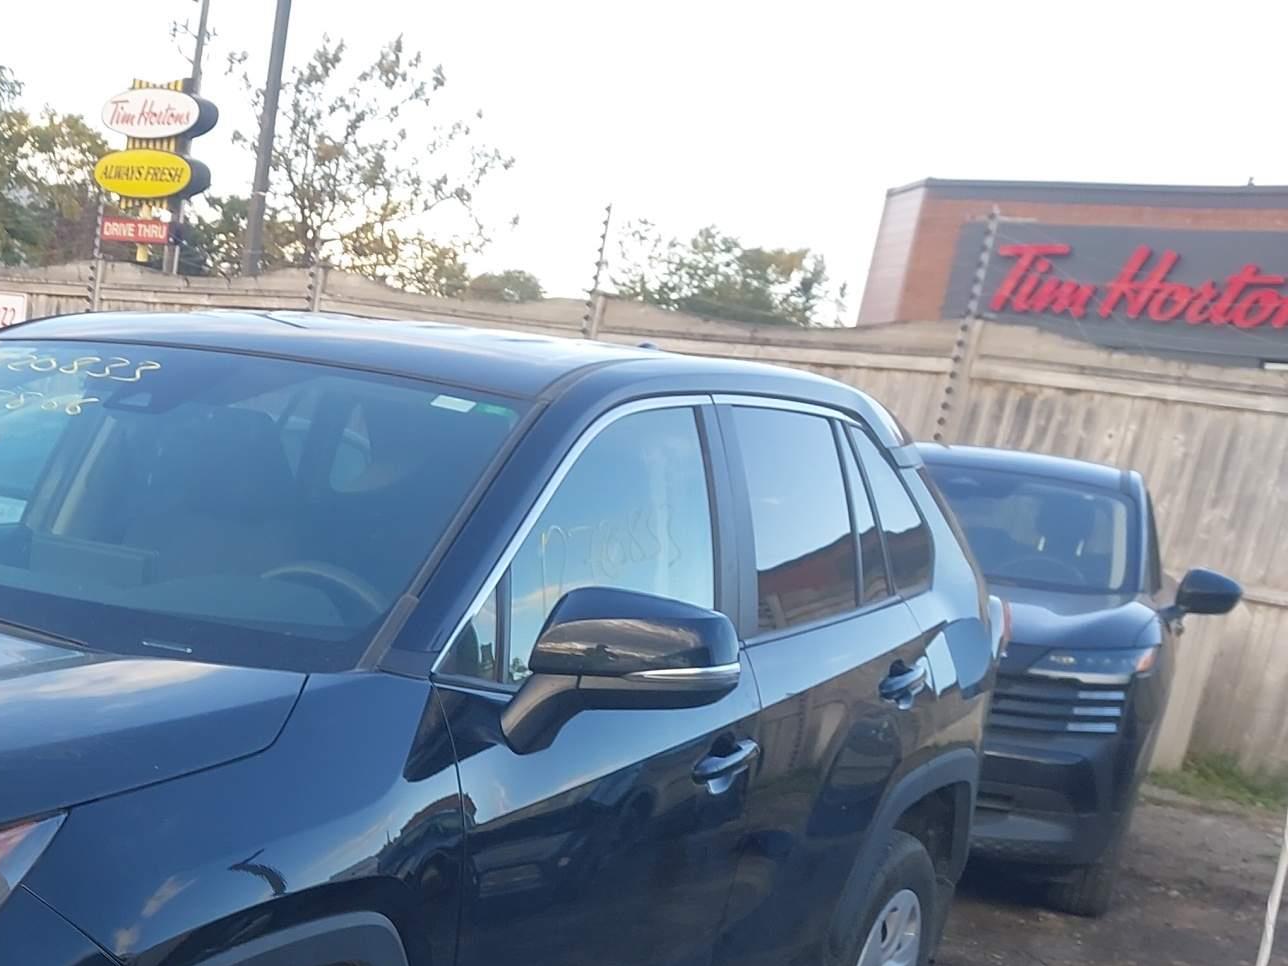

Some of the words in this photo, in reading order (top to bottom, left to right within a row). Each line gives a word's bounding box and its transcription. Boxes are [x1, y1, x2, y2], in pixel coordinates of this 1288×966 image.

[110, 100, 134, 127] Tim
[136, 98, 191, 127] Hortons
[100, 164, 143, 182] ALWAYS
[143, 166, 186, 184] FRESH
[103, 221, 136, 237] DRIVE
[137, 222, 168, 240] THRU
[989, 244, 1096, 319] Tim
